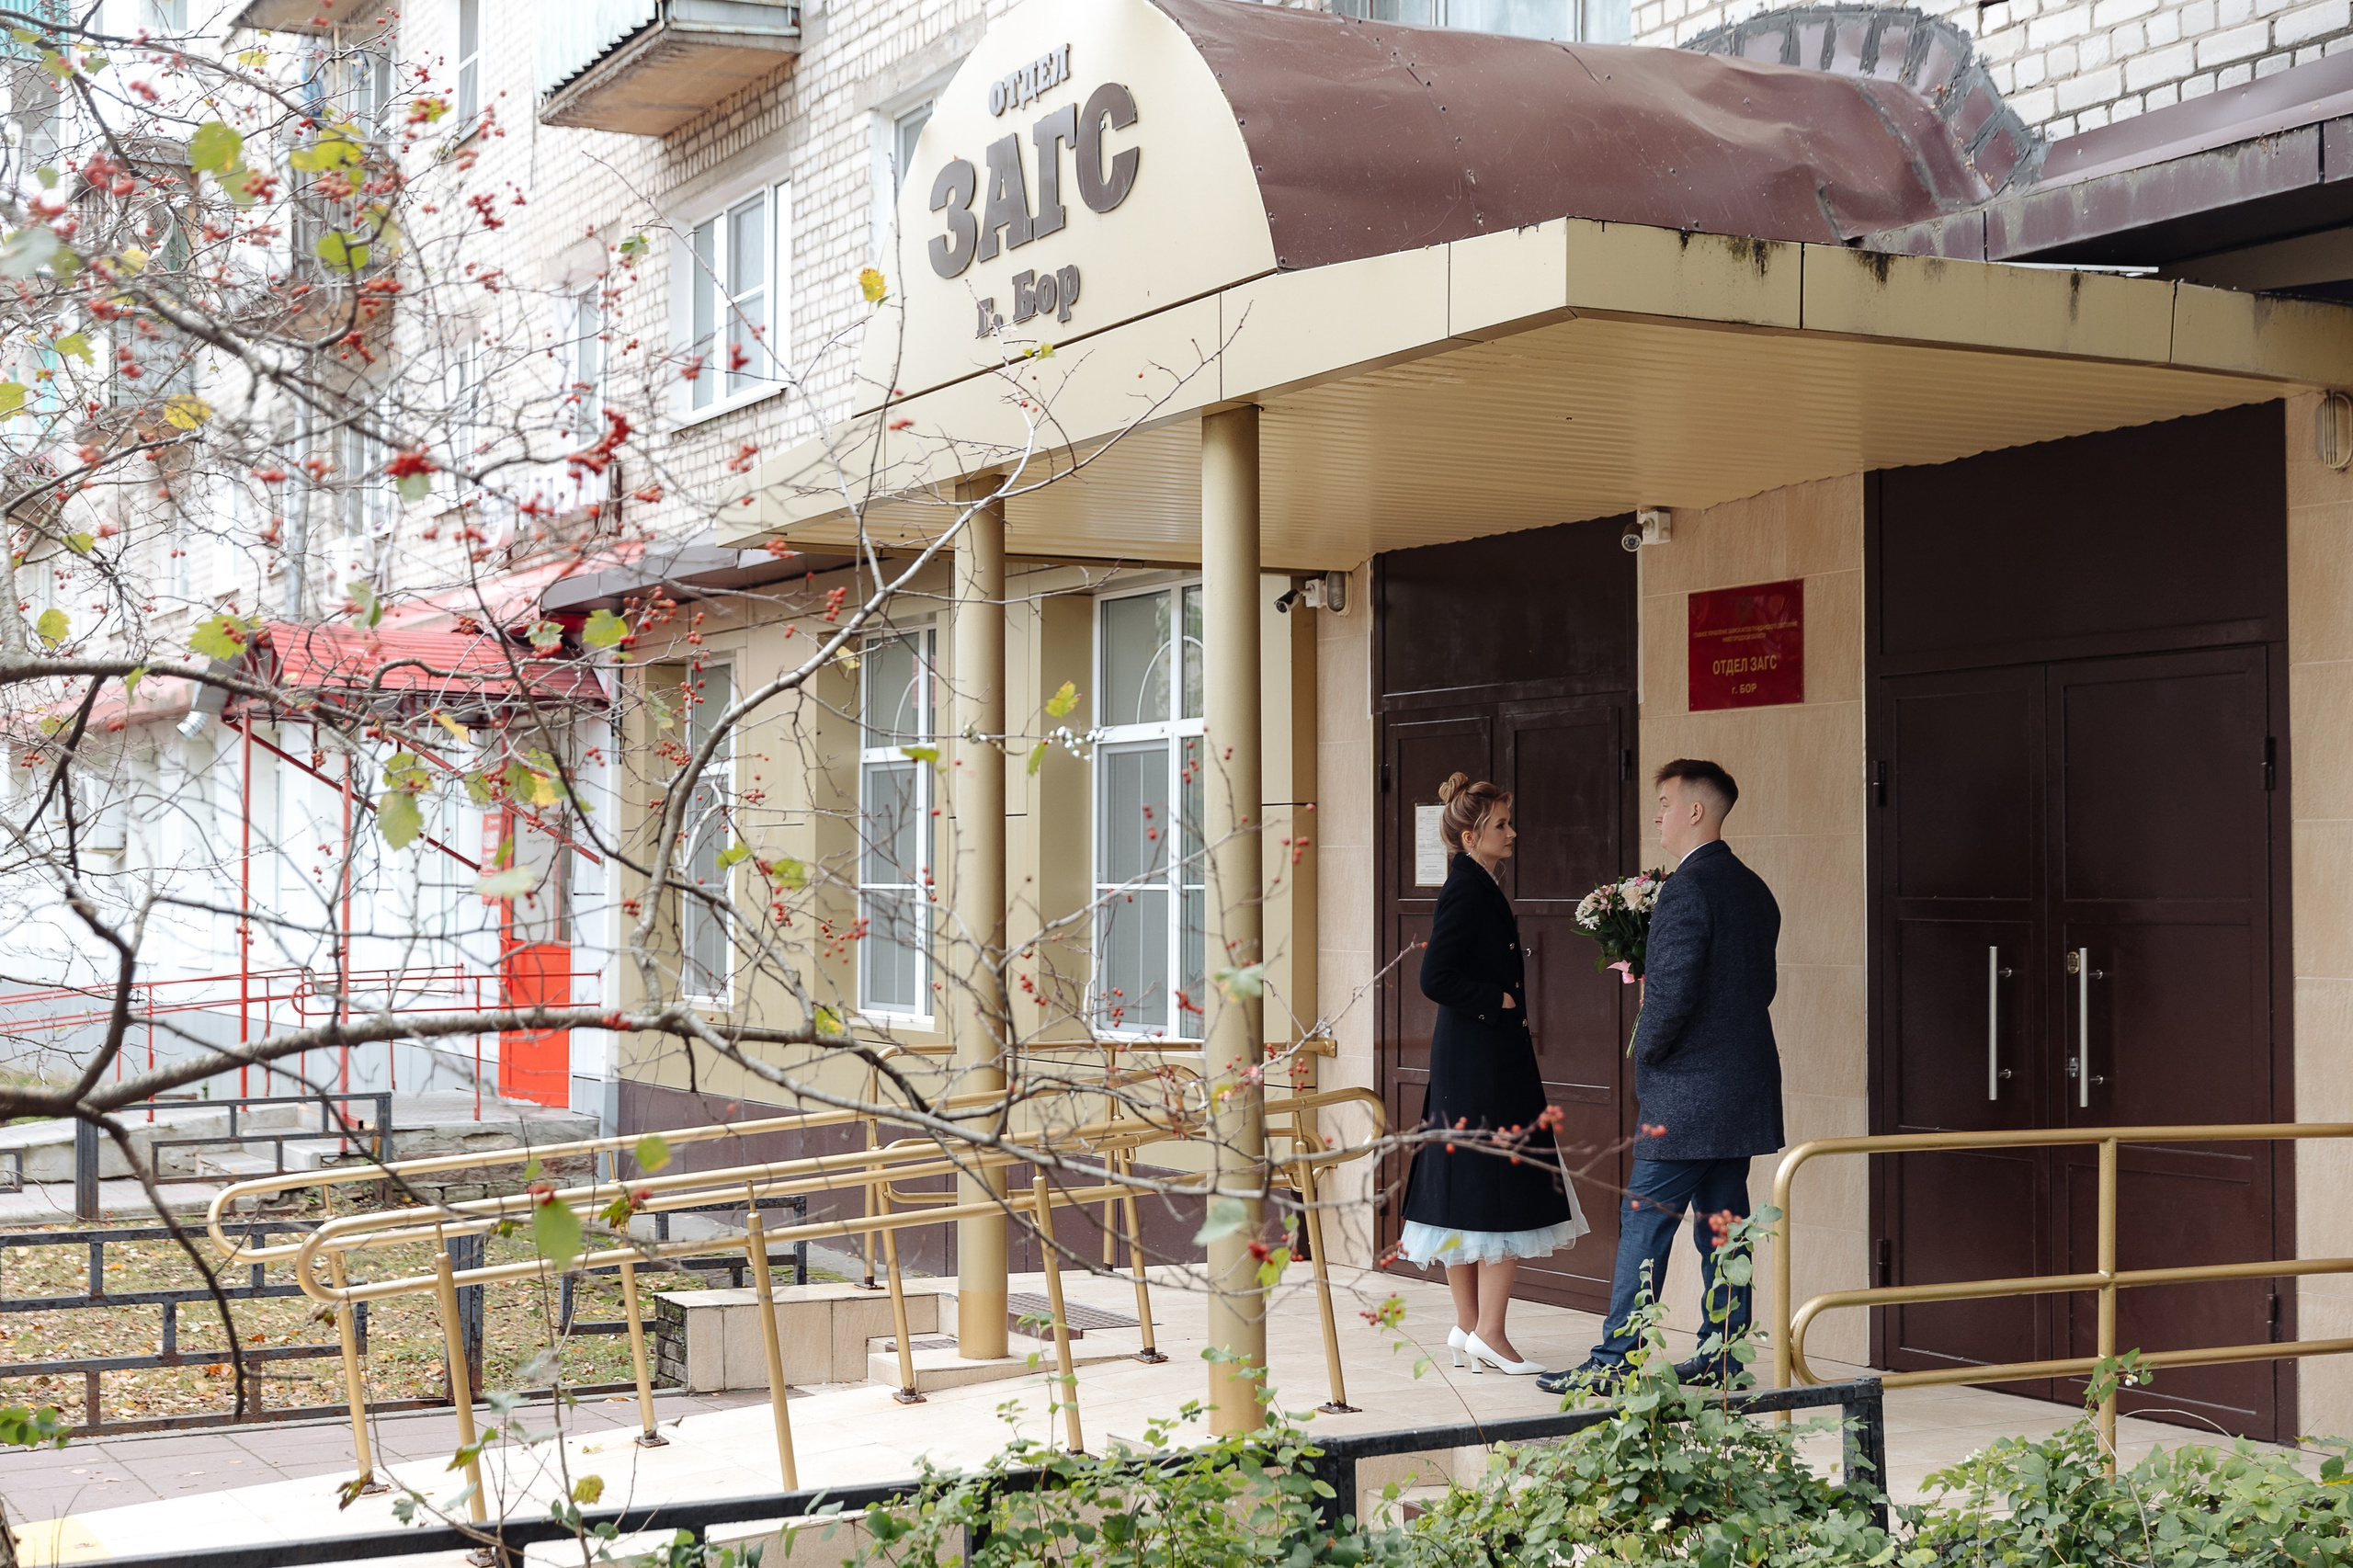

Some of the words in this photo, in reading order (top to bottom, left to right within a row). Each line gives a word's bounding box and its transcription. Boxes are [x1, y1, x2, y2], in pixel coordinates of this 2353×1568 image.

[989, 43, 1070, 117] ОТДЕЛ
[928, 82, 1141, 279] ЗАГС
[1012, 264, 1080, 324] Бор
[1712, 657, 1748, 676] ОТДЕЛ
[1750, 654, 1778, 672] ЗАГС
[1732, 686, 1738, 695] г.
[1739, 683, 1757, 694] БОР
